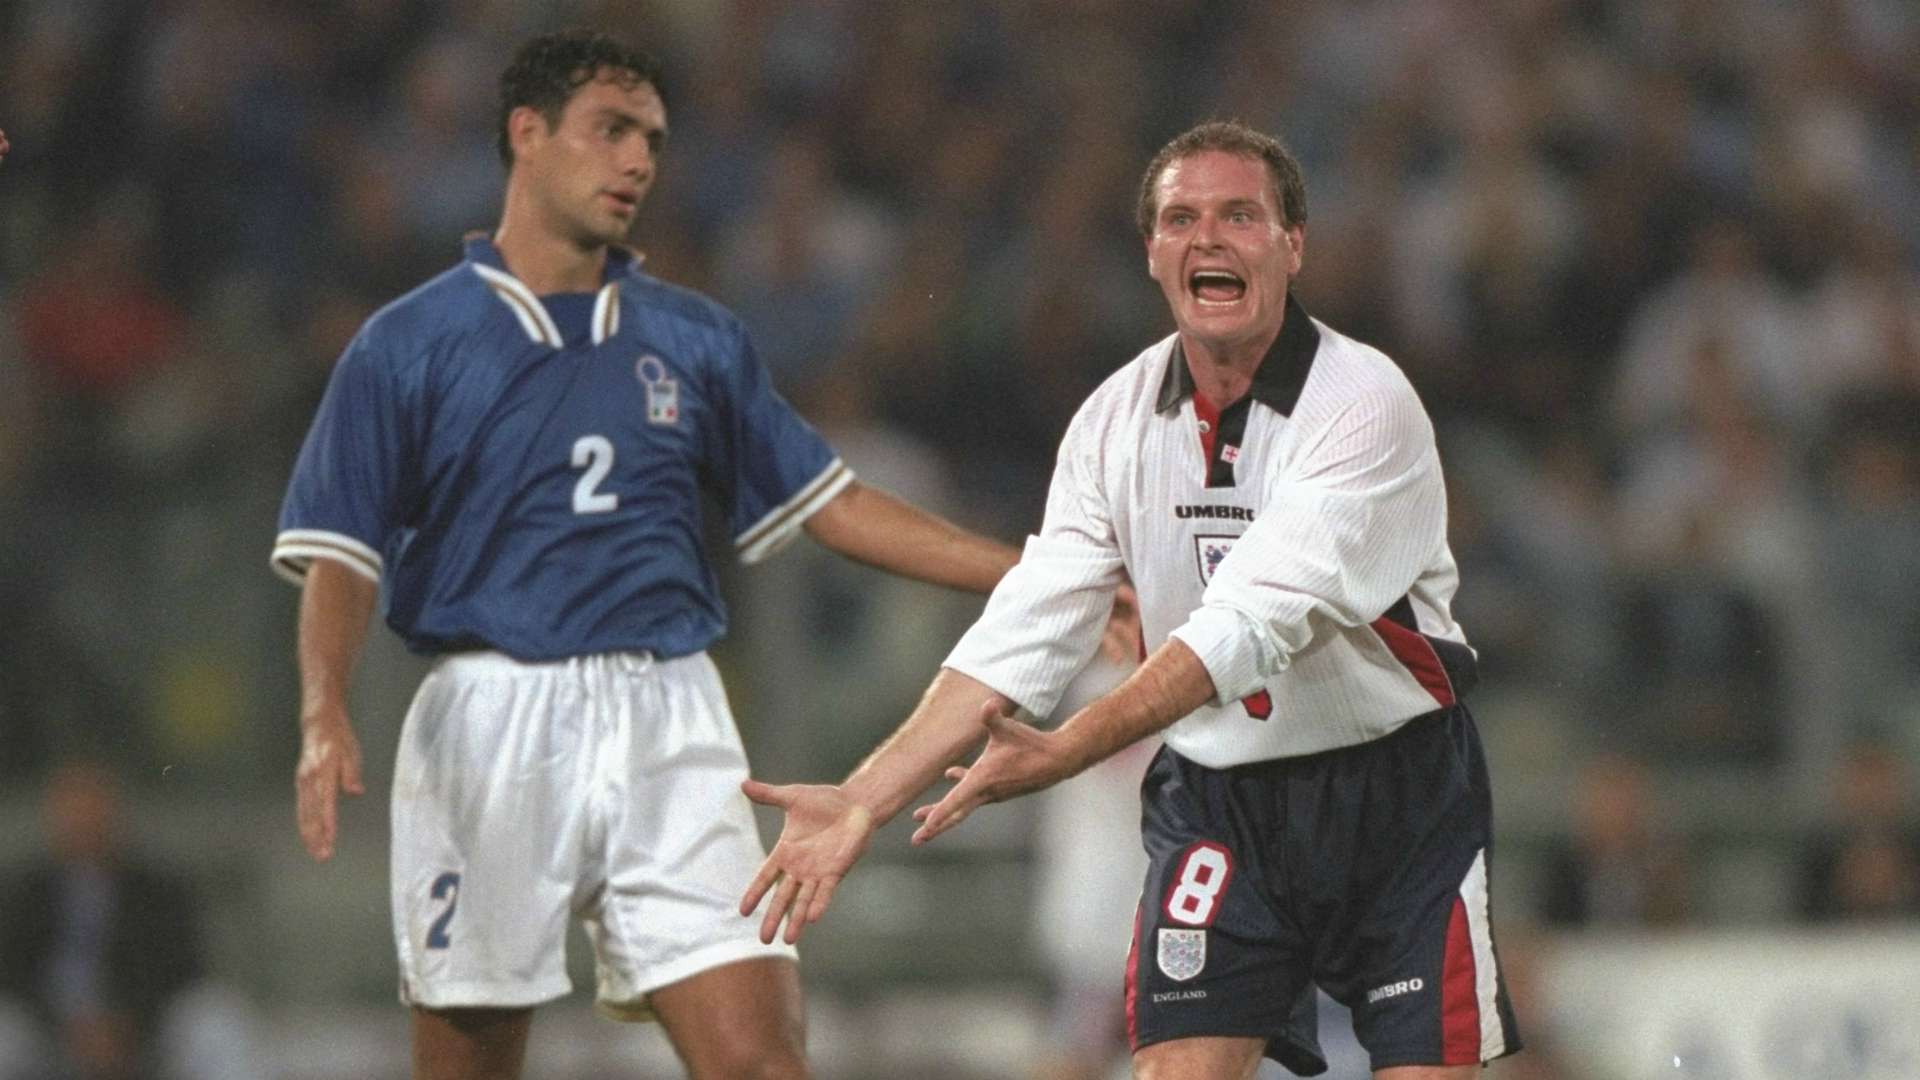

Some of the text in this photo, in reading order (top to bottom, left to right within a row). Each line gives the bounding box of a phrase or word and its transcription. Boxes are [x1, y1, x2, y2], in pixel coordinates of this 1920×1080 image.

[571, 435, 618, 513] 2
[425, 871, 460, 950] 2
[1165, 843, 1230, 926] 8
[1153, 990, 1207, 1003] ENGLAND
